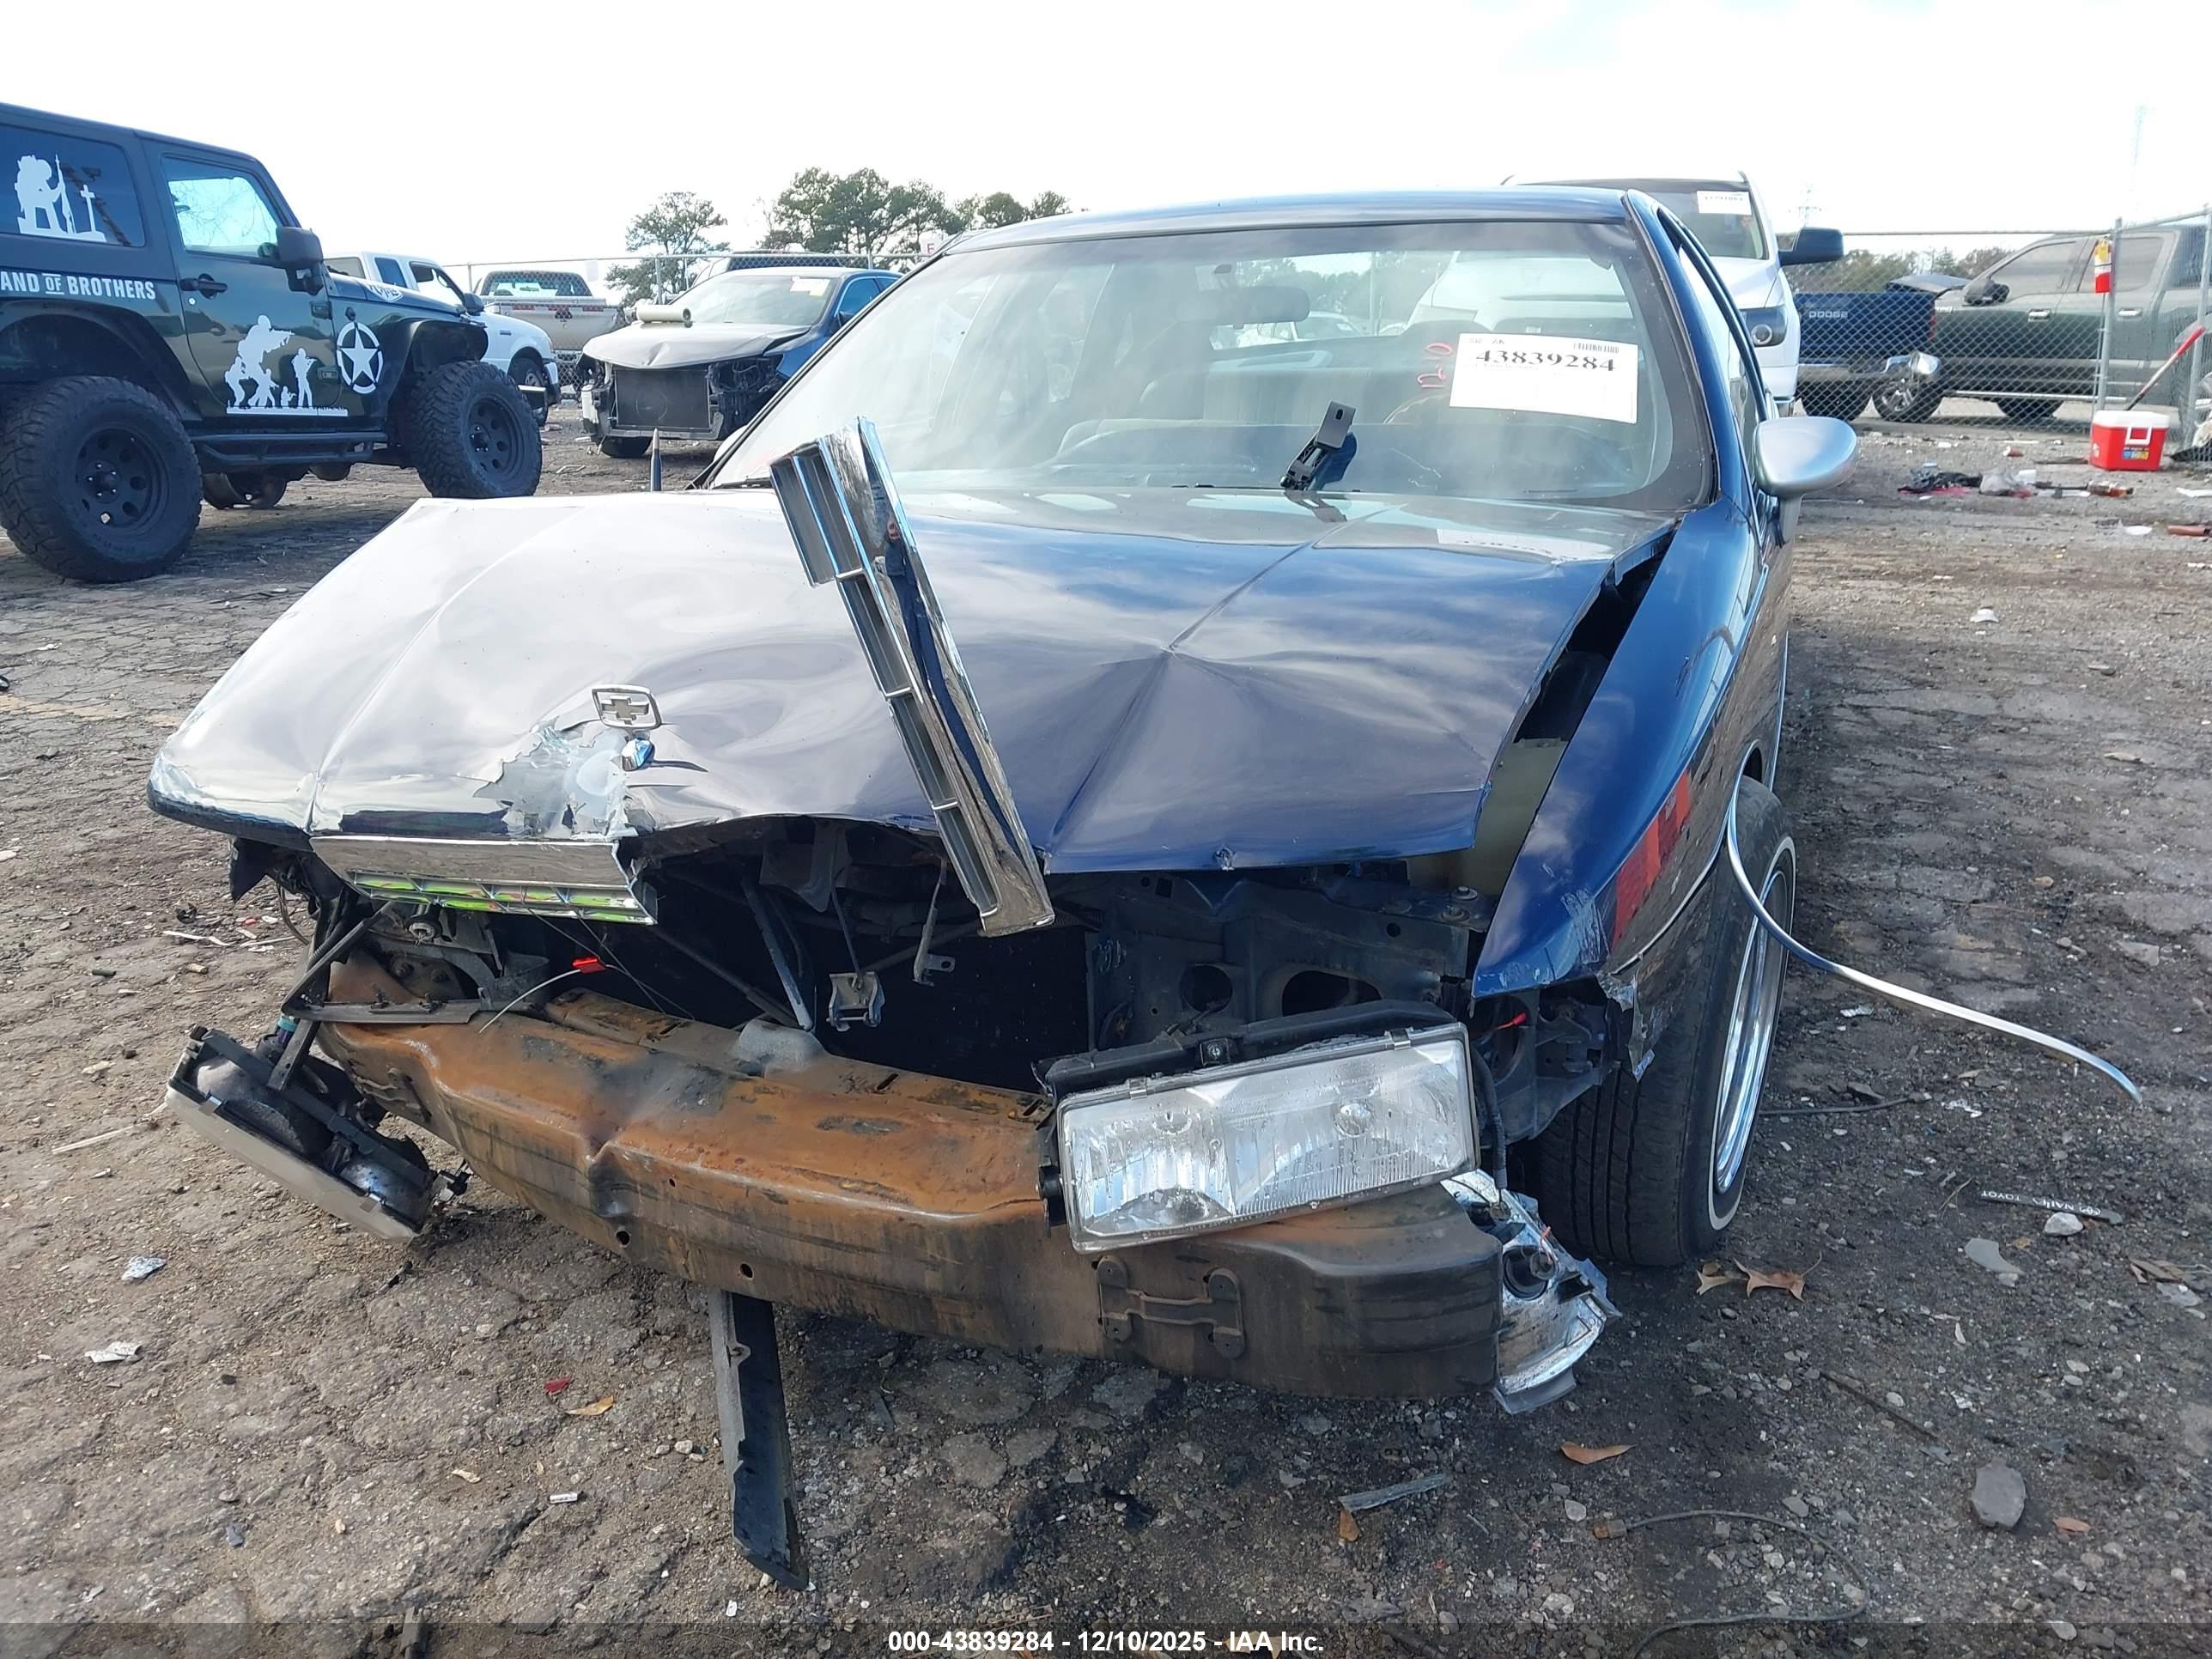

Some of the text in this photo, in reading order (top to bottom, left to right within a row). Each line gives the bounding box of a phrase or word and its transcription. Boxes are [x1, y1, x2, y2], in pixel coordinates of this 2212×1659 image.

[44, 273, 64, 294] OF
[66, 275, 156, 300] BROTHERS
[1808, 310, 1849, 319] DODGE
[1475, 349, 1616, 372] 43839284
